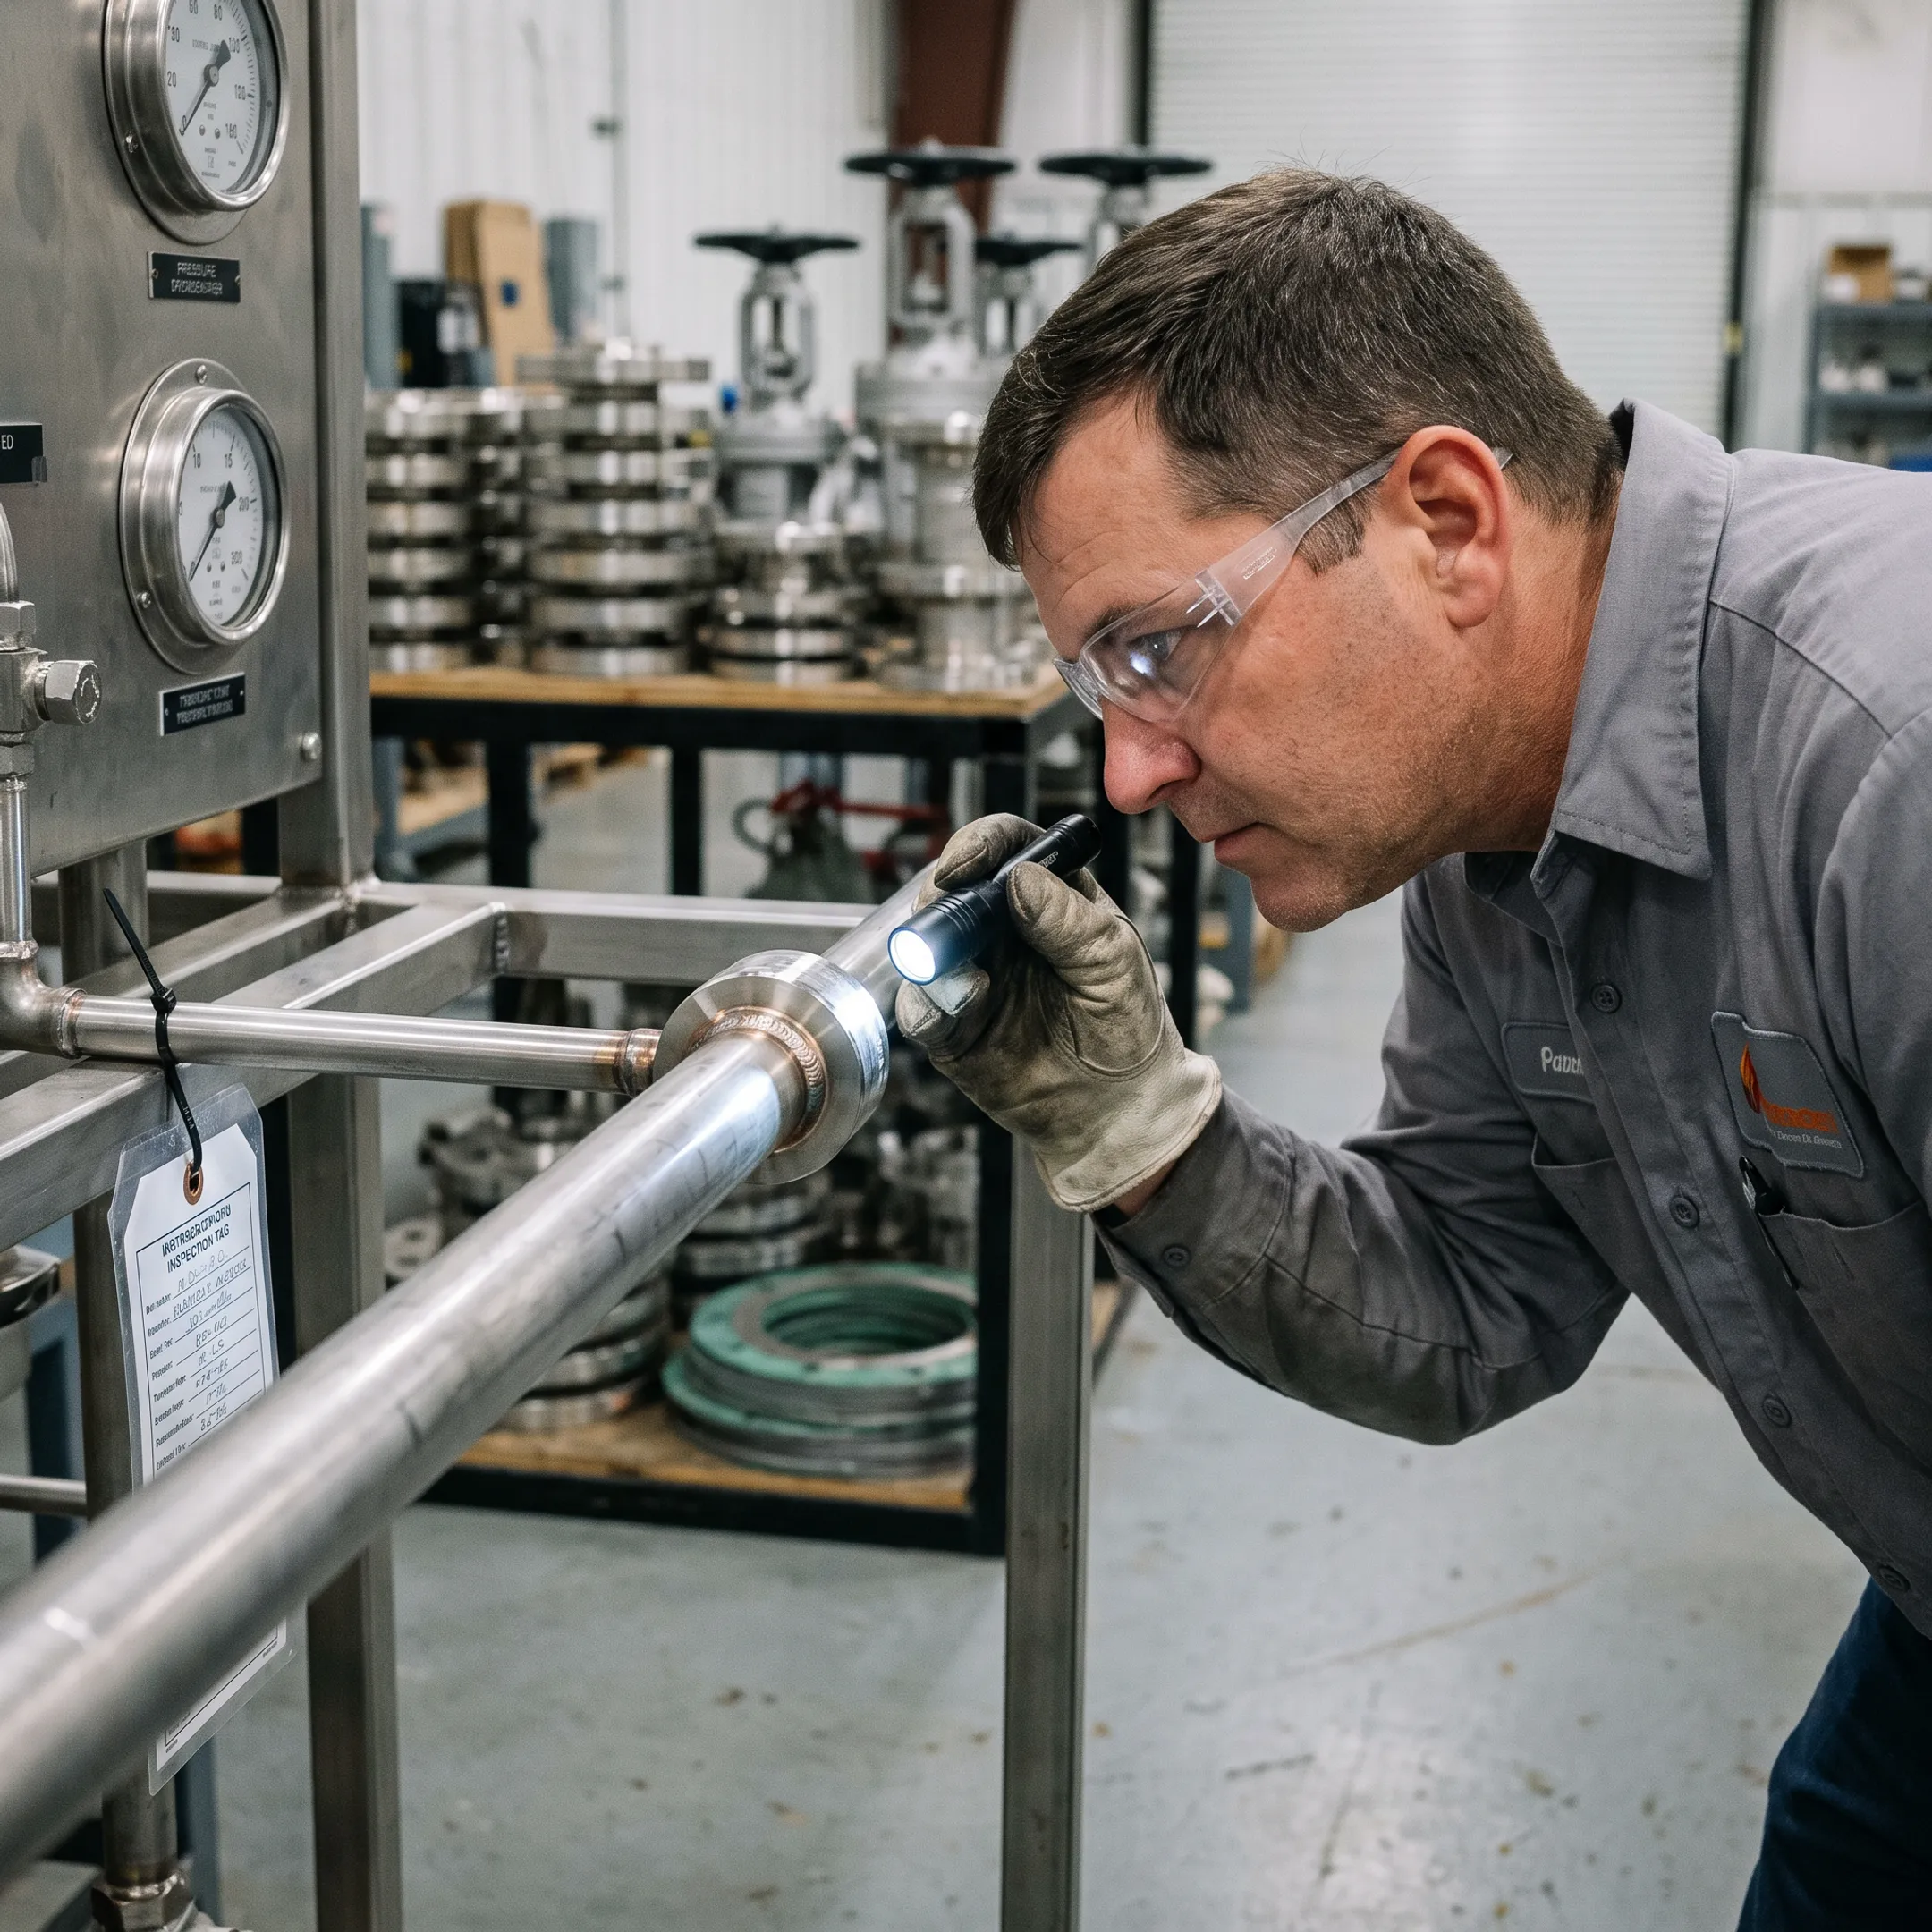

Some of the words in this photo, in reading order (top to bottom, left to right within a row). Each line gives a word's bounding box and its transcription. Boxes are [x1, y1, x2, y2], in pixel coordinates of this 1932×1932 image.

[167, 71, 177, 88] 20
[193, 453, 201, 470] 10
[224, 453, 233, 469] 15
[167, 1233, 214, 1274] INSPECTION
[215, 1223, 230, 1242] TAG
